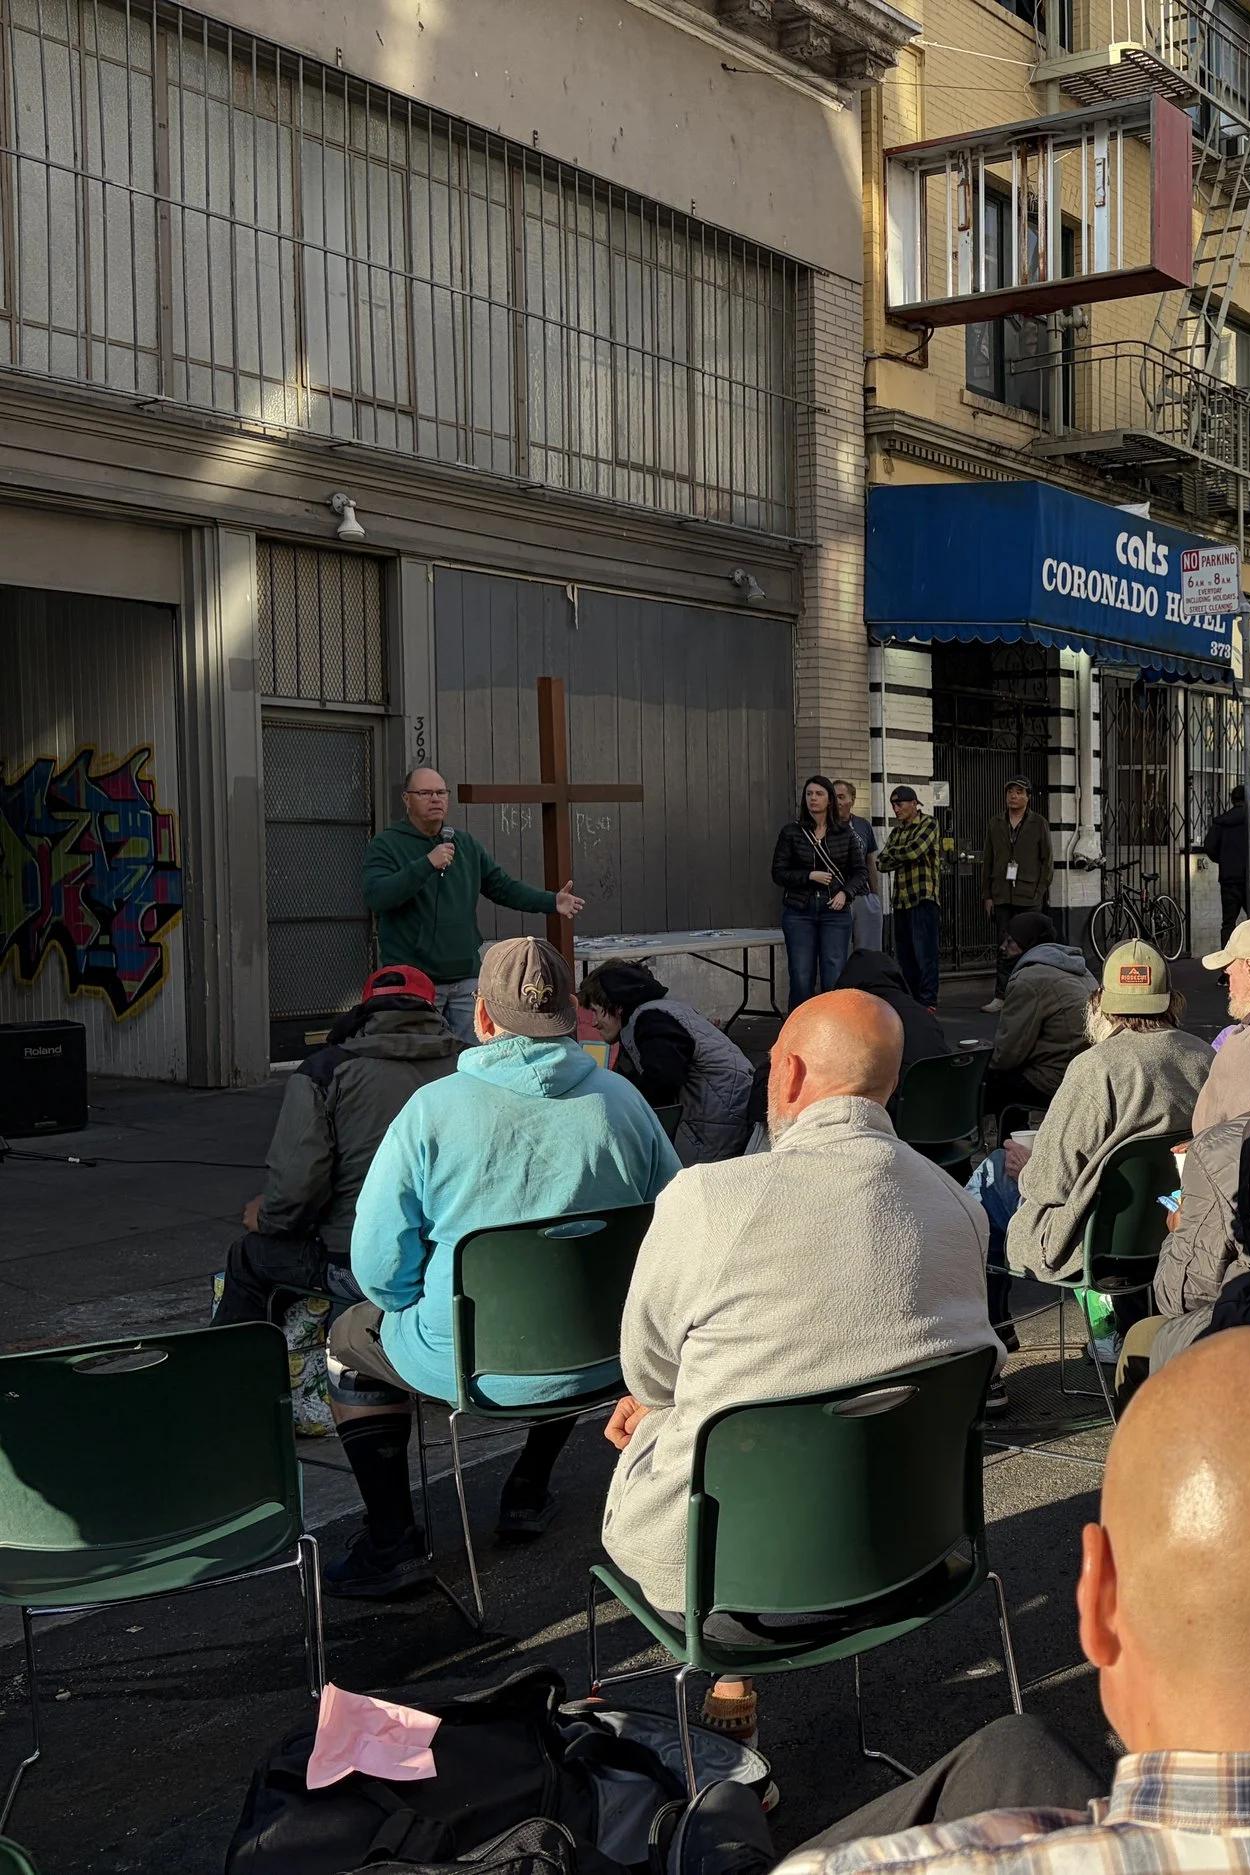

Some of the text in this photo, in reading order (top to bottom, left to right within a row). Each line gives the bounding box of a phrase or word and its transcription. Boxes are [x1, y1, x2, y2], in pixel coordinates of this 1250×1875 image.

[1115, 530, 1169, 576] cats
[1183, 552, 1236, 570] NO PARKING
[1042, 557, 1159, 617] CORONADO
[1187, 576, 1194, 588] 6
[1214, 573, 1221, 585] 8
[1186, 593, 1236, 604] INCLUDING HOLIDAYS
[1198, 587, 1222, 596] EVERYDAY
[1189, 603, 1233, 613] STREET CLEANING
[1210, 641, 1231, 659] 373
[414, 716, 426, 764] 369
[24, 1045, 62, 1057] Roland
